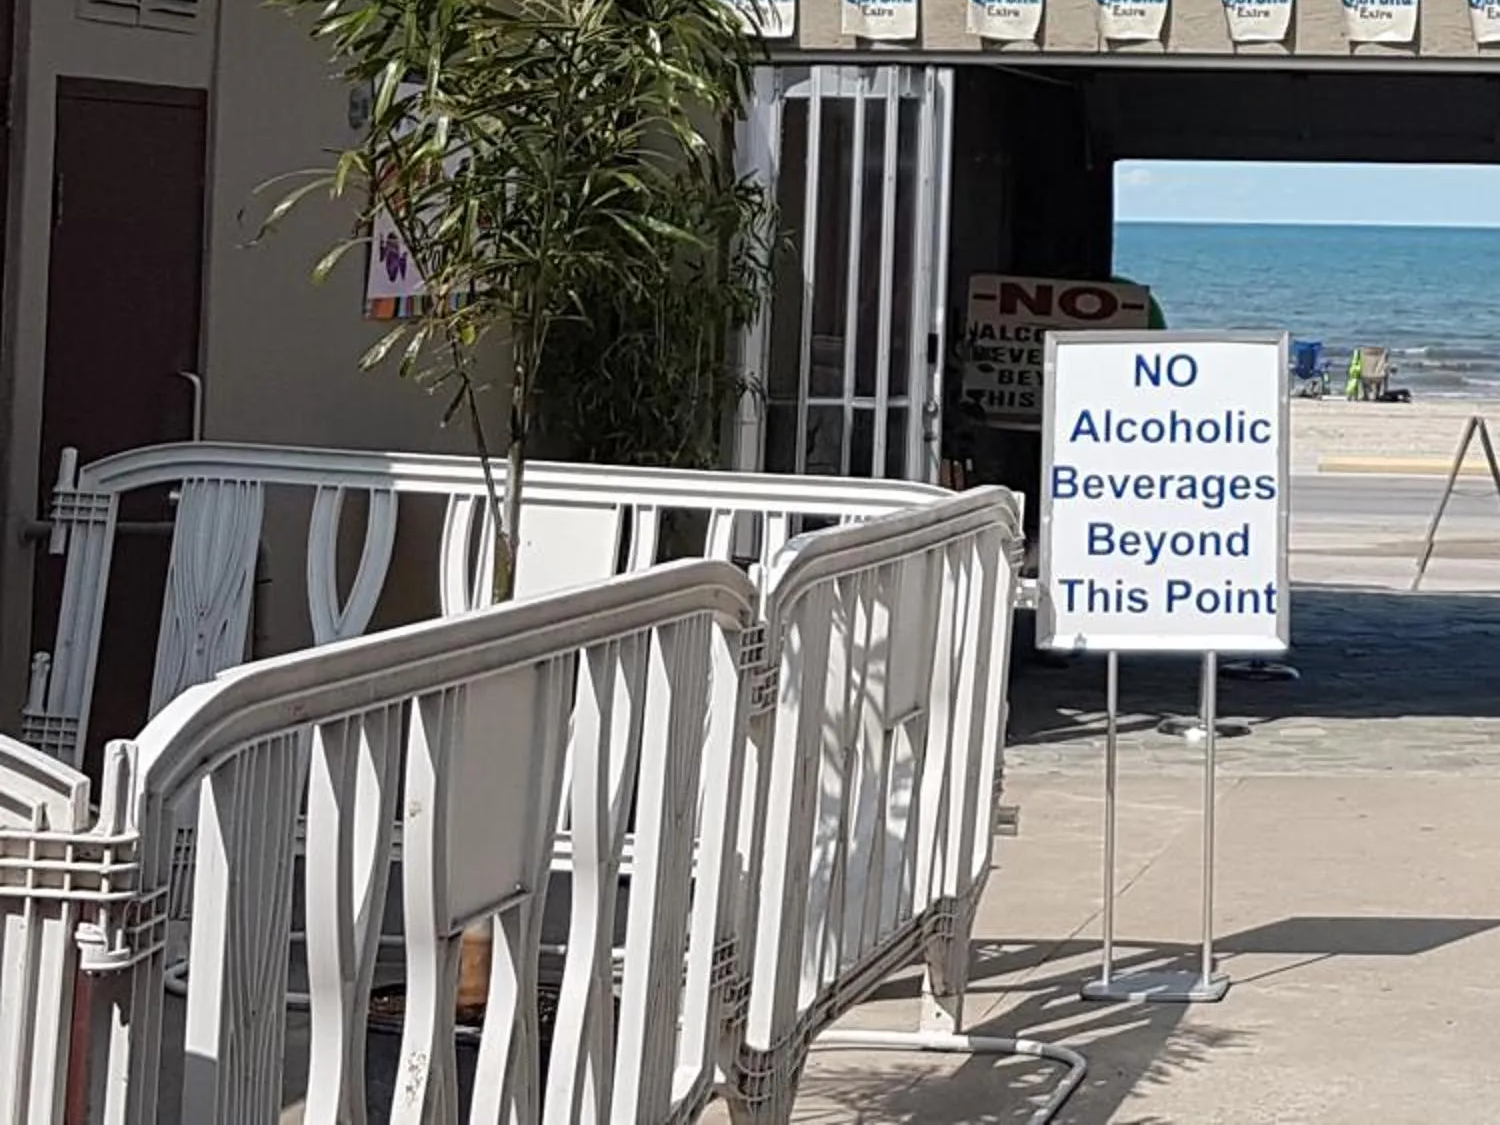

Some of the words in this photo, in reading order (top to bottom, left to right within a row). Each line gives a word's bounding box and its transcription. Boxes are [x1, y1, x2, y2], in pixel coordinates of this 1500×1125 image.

[862, 5, 894, 17] Extra
[987, 5, 1020, 17] Extra
[1113, 5, 1145, 17] Extra
[1237, 6, 1270, 18] Extra
[1359, 7, 1393, 19] Extra
[1134, 353, 1198, 387] NO
[1069, 410, 1271, 444] Alcoholic
[1051, 465, 1276, 510] Beverages
[1087, 522, 1250, 565] Beyond
[1058, 578, 1149, 613] This
[1166, 580, 1278, 614] Point
